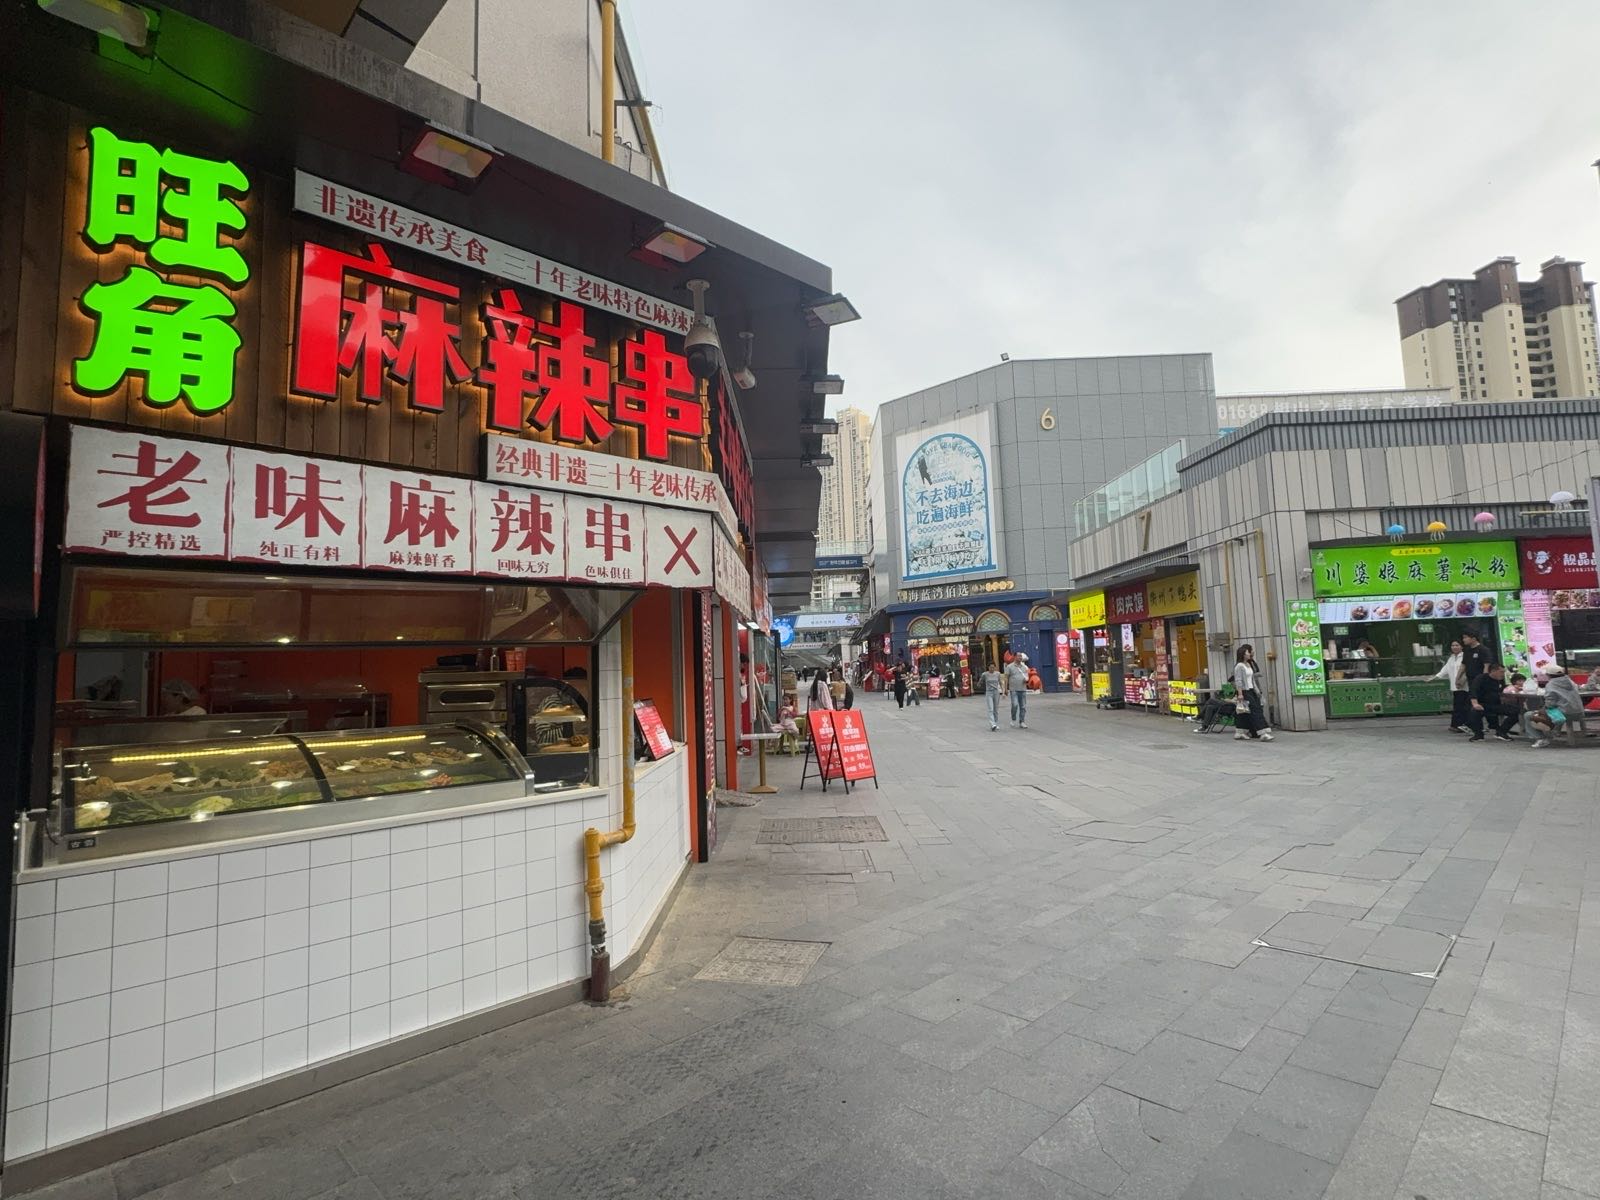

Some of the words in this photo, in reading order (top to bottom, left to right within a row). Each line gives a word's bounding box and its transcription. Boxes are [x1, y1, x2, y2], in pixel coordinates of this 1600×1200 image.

[75, 127, 249, 411] 旺角
[313, 184, 489, 266] 非遗传承美食
[502, 249, 695, 334] 三十年老味特色麻辣
[291, 241, 704, 460] 麻辣串
[1040, 408, 1056, 431] 6
[495, 443, 718, 506] 经典非遗三十年老味传承
[916, 480, 973, 507] 不去海边
[916, 504, 974, 525] 吃遍海鲜
[101, 529, 201, 552] 严控精选
[1136, 511, 1151, 551] 7
[260, 540, 341, 562] 纯正有料
[389, 551, 456, 569] 麻辣鲜香
[498, 558, 549, 574] 回味无穷
[585, 564, 633, 580] 色味俱佳
[1326, 556, 1509, 587] 川婆娘麻薯冰粉
[1116, 592, 1144, 615] 肉夹馍
